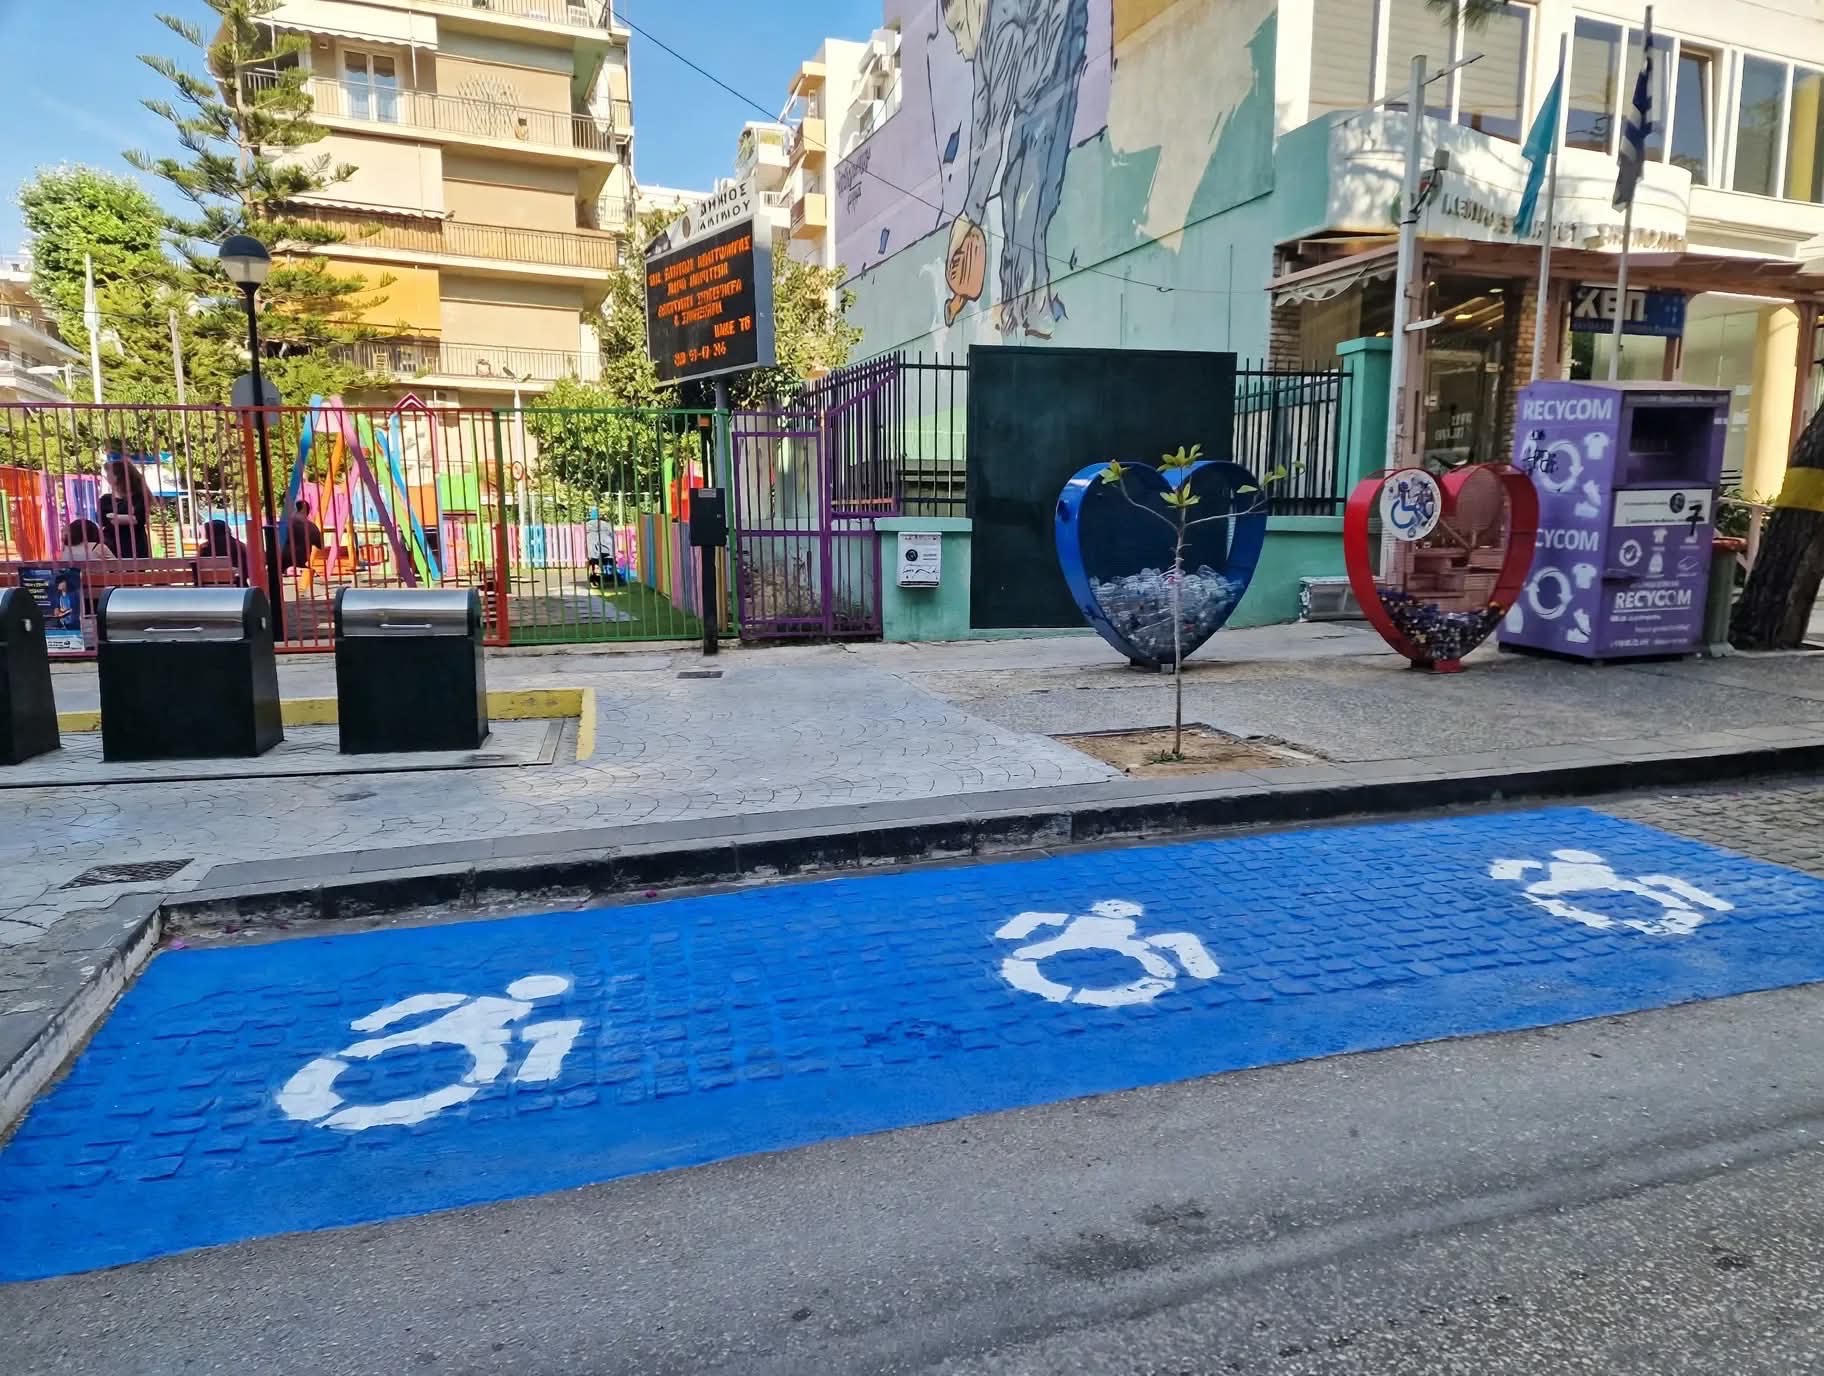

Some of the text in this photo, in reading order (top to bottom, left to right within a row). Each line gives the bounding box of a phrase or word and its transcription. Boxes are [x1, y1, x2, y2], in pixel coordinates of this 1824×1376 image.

[700, 183, 746, 217] ΔΗΜΟΣ
[700, 200, 750, 230] ΑΛΙΜΟΥ
[1523, 398, 1613, 420] RECYCOM
[1535, 528, 1599, 551] CYCOM
[1615, 589, 1692, 608] RECYCOM
